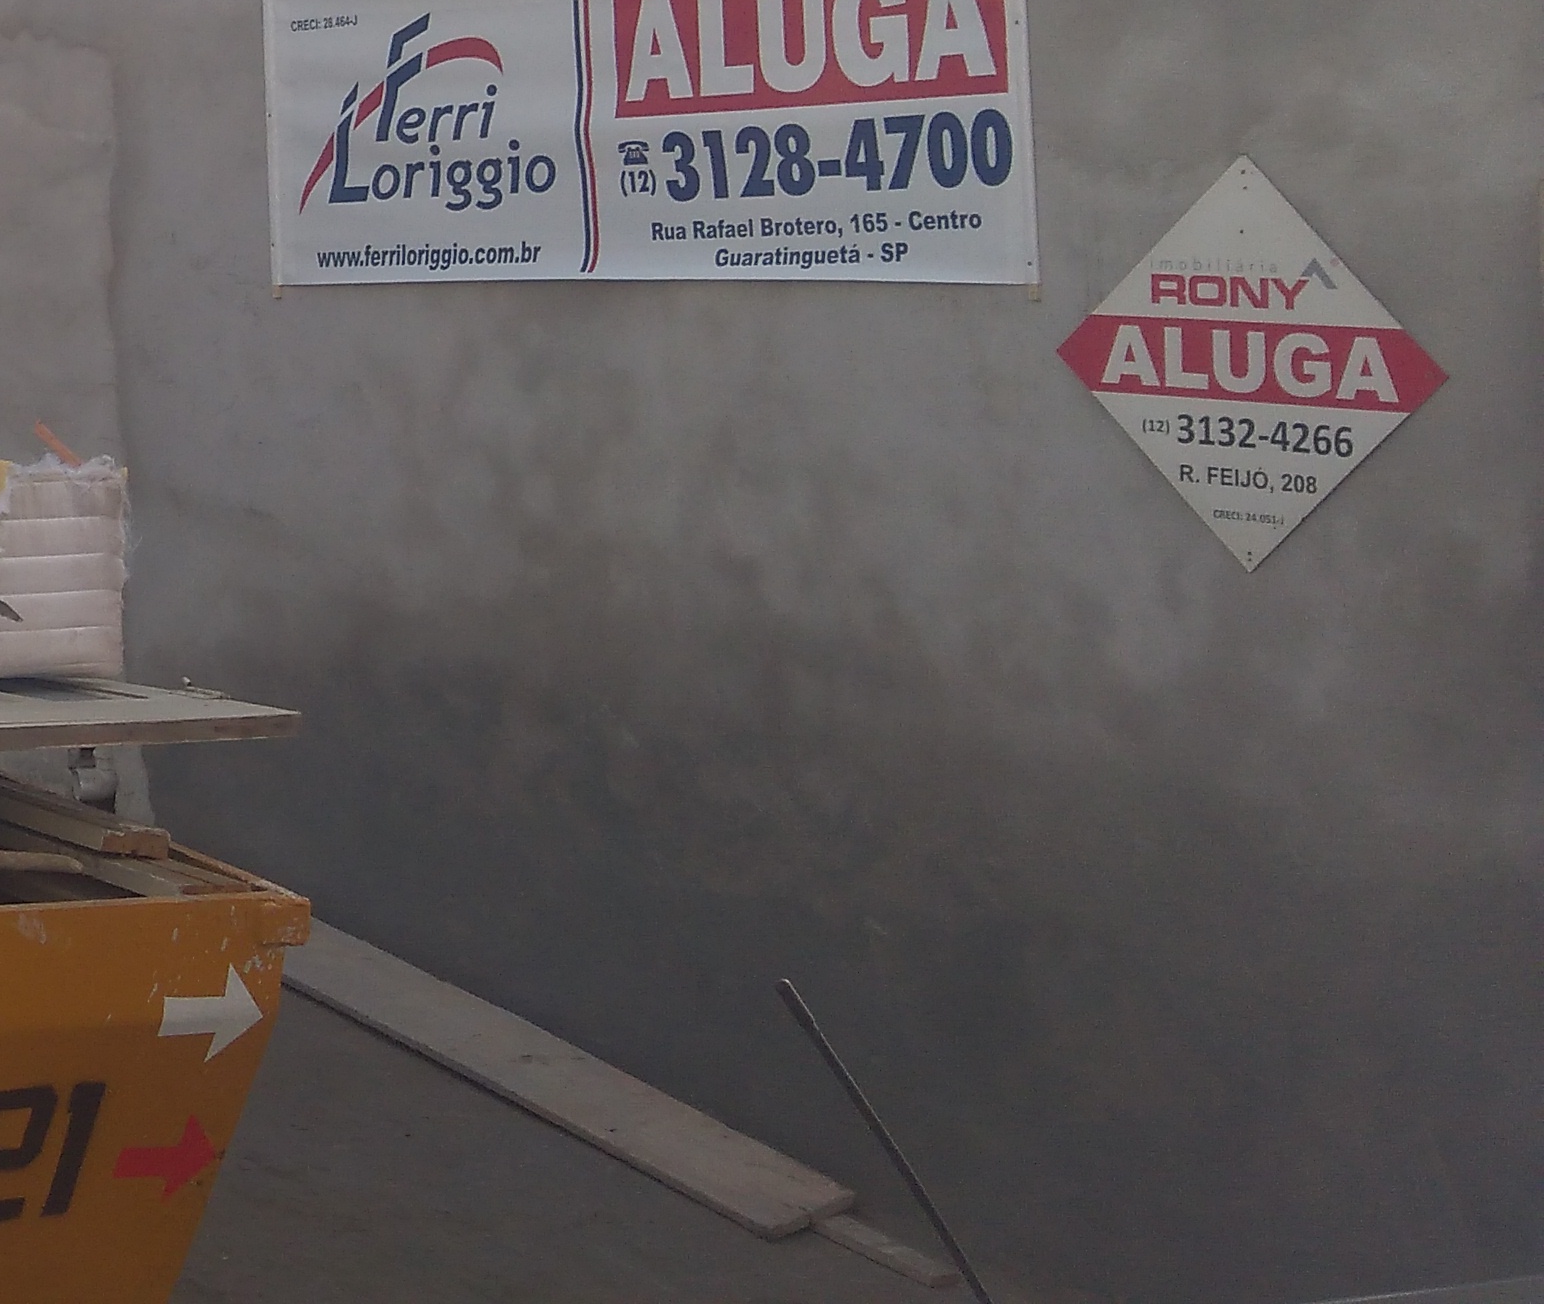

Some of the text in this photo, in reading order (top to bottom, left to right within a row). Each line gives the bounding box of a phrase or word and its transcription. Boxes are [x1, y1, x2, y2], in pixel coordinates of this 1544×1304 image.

[375, 12, 498, 144] Ferri
[328, 82, 557, 211] Loriggio
[620, 108, 1012, 203] (12) 3128-4700
[651, 222, 687, 241] Rua
[693, 218, 754, 240] Rafael
[760, 216, 844, 238] Brotero,
[850, 212, 889, 233] 165
[908, 210, 982, 232] Centro
[317, 241, 541, 271] www.ferriloriggio.com.br
[715, 244, 861, 269] Guaratinguetá
[880, 243, 909, 264] SP
[1151, 273, 1310, 310] RONY
[1101, 324, 1400, 404] ALUGA
[1142, 414, 1354, 458] (12) 3132-4266
[1180, 464, 1317, 494] R. FEIJÓ, 208
